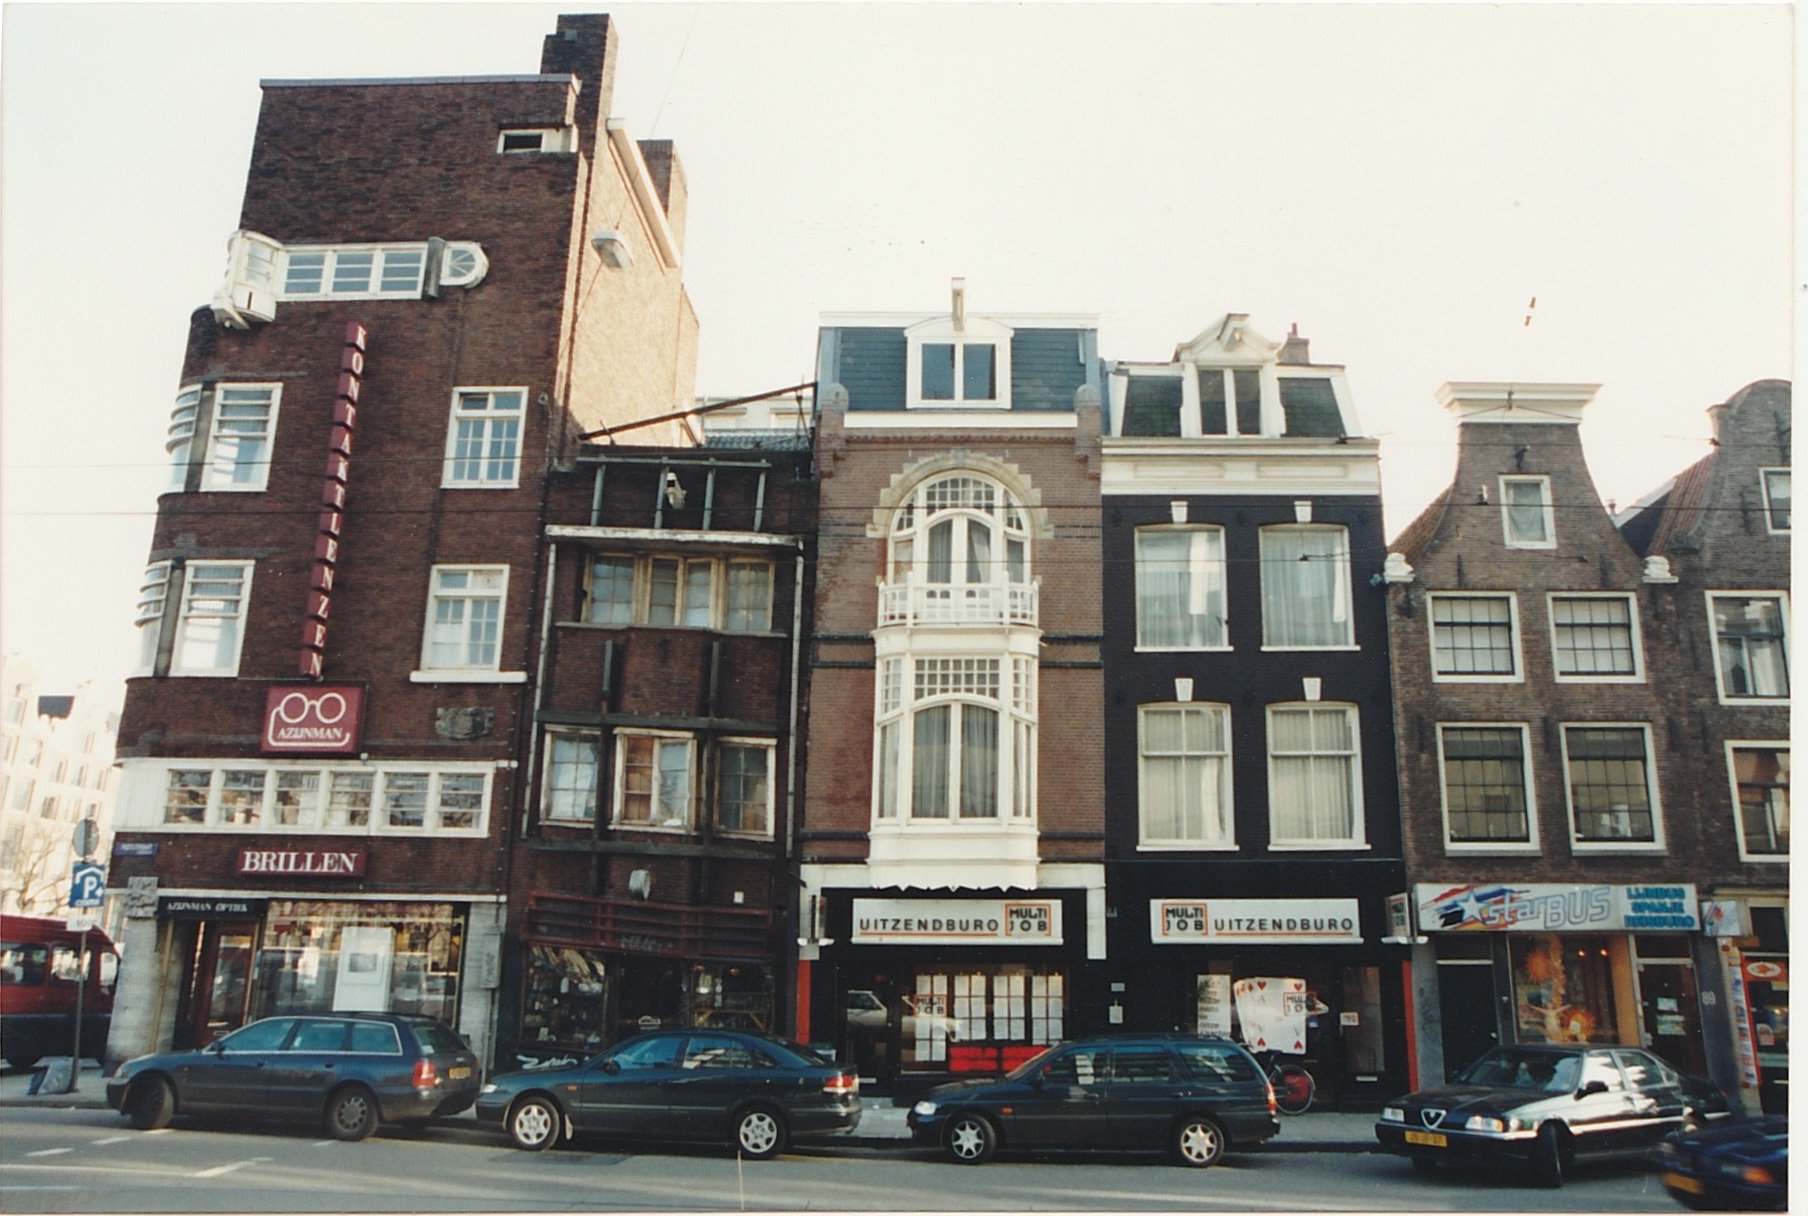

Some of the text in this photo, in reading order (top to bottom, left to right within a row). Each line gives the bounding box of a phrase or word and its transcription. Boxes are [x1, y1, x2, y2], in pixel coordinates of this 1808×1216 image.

[310, 326, 367, 678] KONTAKTLENZEN
[242, 851, 357, 873] BRILLEN
[83, 876, 98, 899] P
[1009, 907, 1047, 919] MULTI
[1166, 907, 1203, 919] MULTI
[860, 918, 999, 932] UITZENDBURO
[1009, 920, 1047, 932] JOB
[1165, 919, 1204, 931] JOB
[1215, 918, 1353, 931] UITZENDBURO
